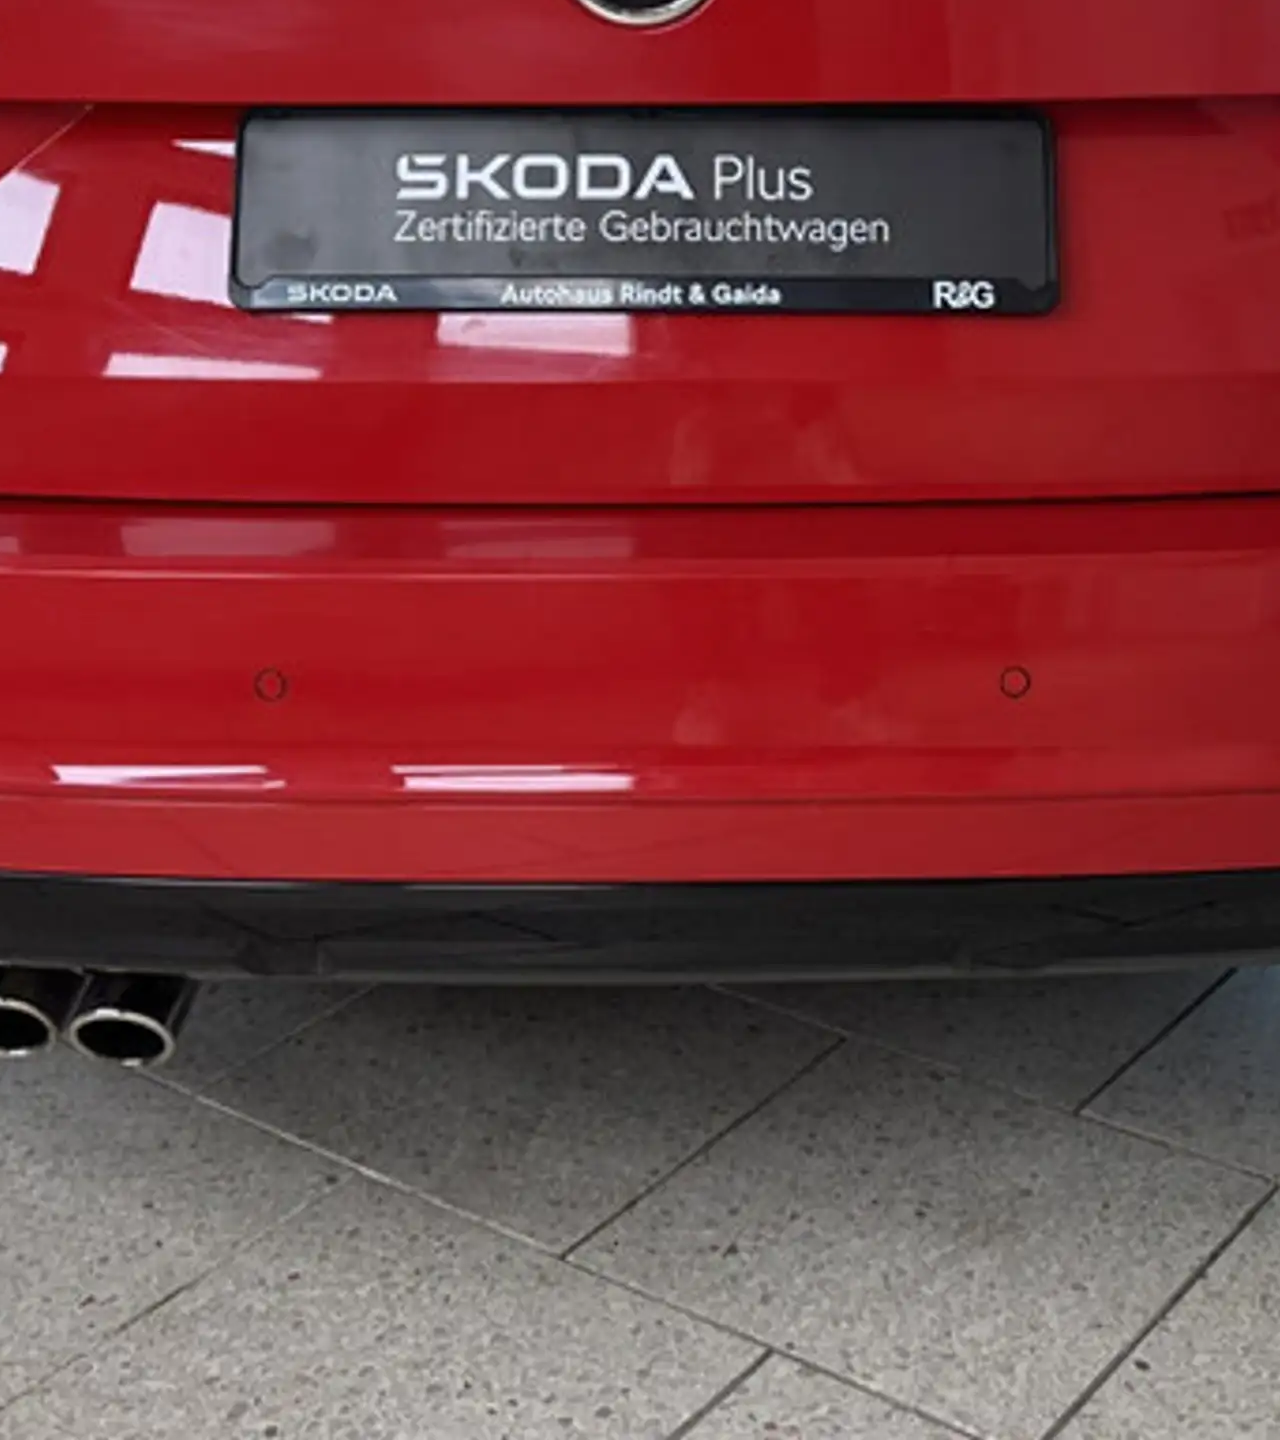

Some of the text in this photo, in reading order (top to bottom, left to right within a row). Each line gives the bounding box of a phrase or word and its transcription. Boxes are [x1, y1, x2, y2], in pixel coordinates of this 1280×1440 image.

[714, 154, 815, 201] Plus
[394, 209, 891, 253] Zertifizierte Gebrauchtwagen
[499, 282, 783, 306] Autohaus Rindt & Gaida
[933, 280, 996, 309] R&G
